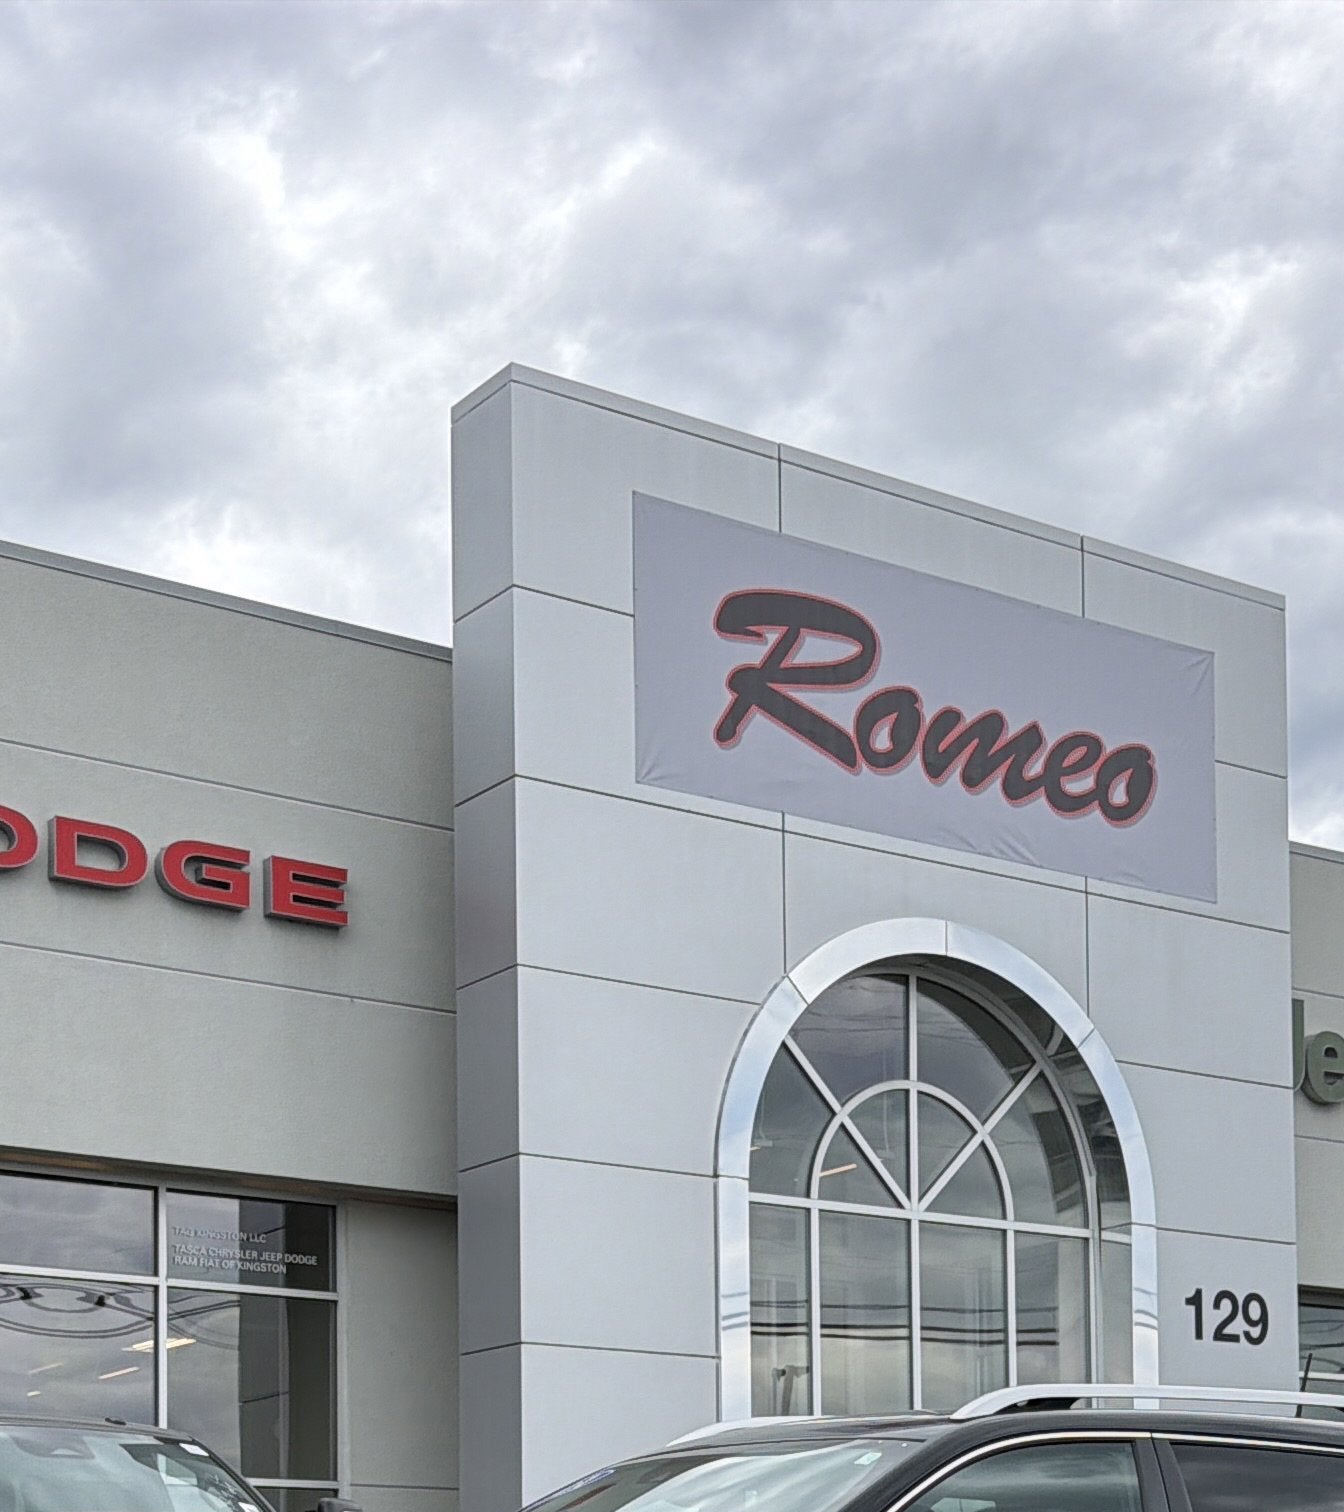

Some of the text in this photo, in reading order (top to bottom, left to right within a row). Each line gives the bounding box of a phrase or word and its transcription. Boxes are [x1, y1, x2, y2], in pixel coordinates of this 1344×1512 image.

[712, 587, 1156, 828] Romeo
[249, 1231, 267, 1244] LLC
[174, 1244, 318, 1266] TASCA CHRYSLER JEEP DODGE
[174, 1256, 198, 1267] RAM
[221, 1259, 236, 1270] OF
[237, 1261, 286, 1275] KINGSTON
[1184, 1287, 1270, 1346] 129
